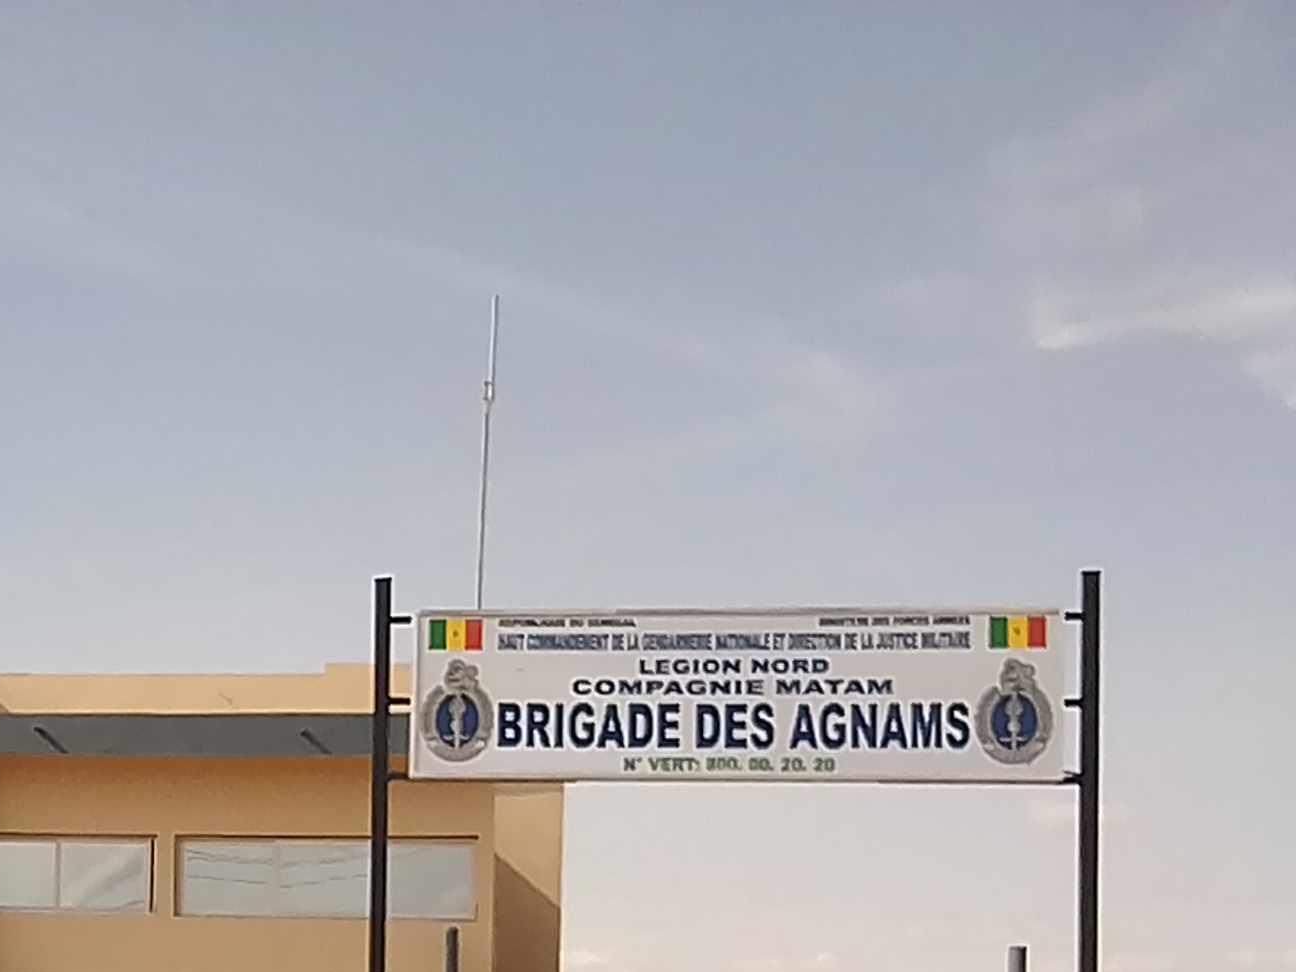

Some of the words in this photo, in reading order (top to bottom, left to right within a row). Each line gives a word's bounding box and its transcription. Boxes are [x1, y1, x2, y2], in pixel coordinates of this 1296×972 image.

[611, 633, 625, 651] DE
[627, 633, 639, 651] LA
[773, 633, 787, 650] ET
[844, 632, 857, 650] DE
[860, 632, 873, 650] LA
[876, 632, 918, 649] JUSTICE
[639, 659, 741, 675] LEGION
[751, 658, 830, 674] NORD
[572, 679, 764, 695] COMPAGNIE
[775, 679, 894, 695] MATAM
[496, 702, 680, 748] BRIGADE
[695, 703, 774, 749] DES
[789, 702, 970, 749] AGNAMS
[813, 758, 835, 771] 20
